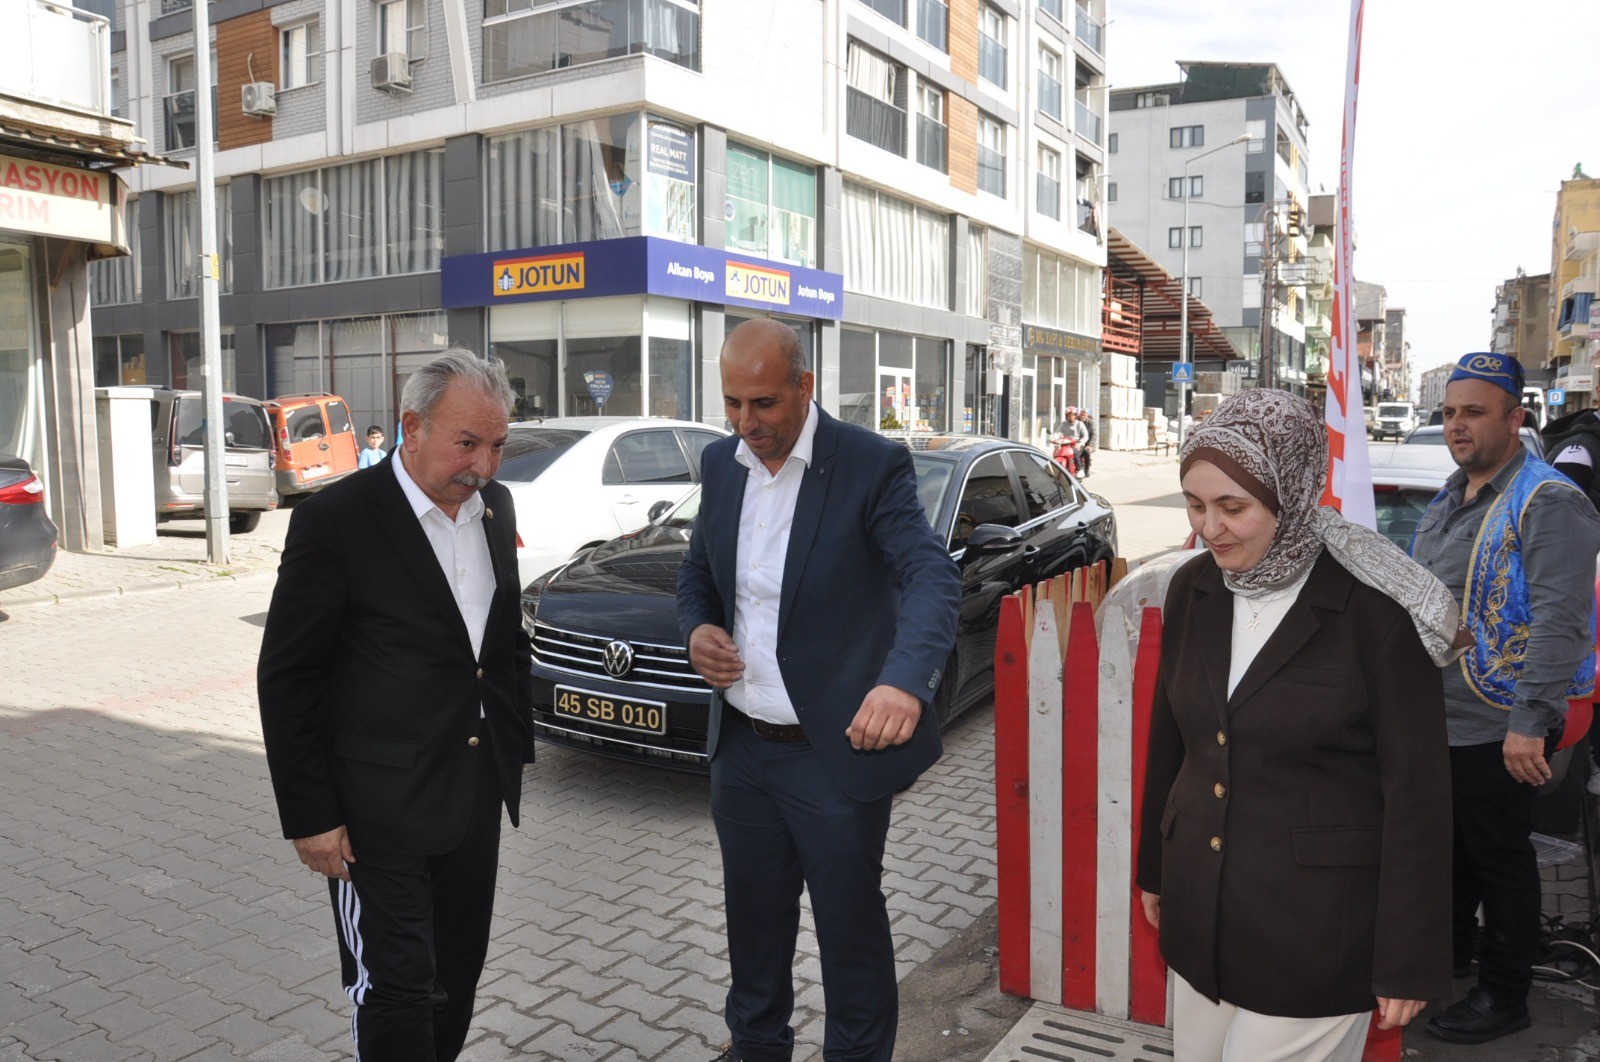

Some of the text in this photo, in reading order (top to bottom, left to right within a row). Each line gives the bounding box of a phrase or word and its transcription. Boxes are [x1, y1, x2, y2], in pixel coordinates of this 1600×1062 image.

[651, 143, 669, 157] REAL
[670, 148, 687, 161] MATT
[0, 161, 99, 201] ASYON
[516, 262, 580, 289] JOTUN
[667, 262, 715, 283] Alkan Boya
[743, 275, 787, 299] JOTUN
[797, 285, 835, 304] Jotun Boya
[559, 692, 660, 729] 45 SB 010
